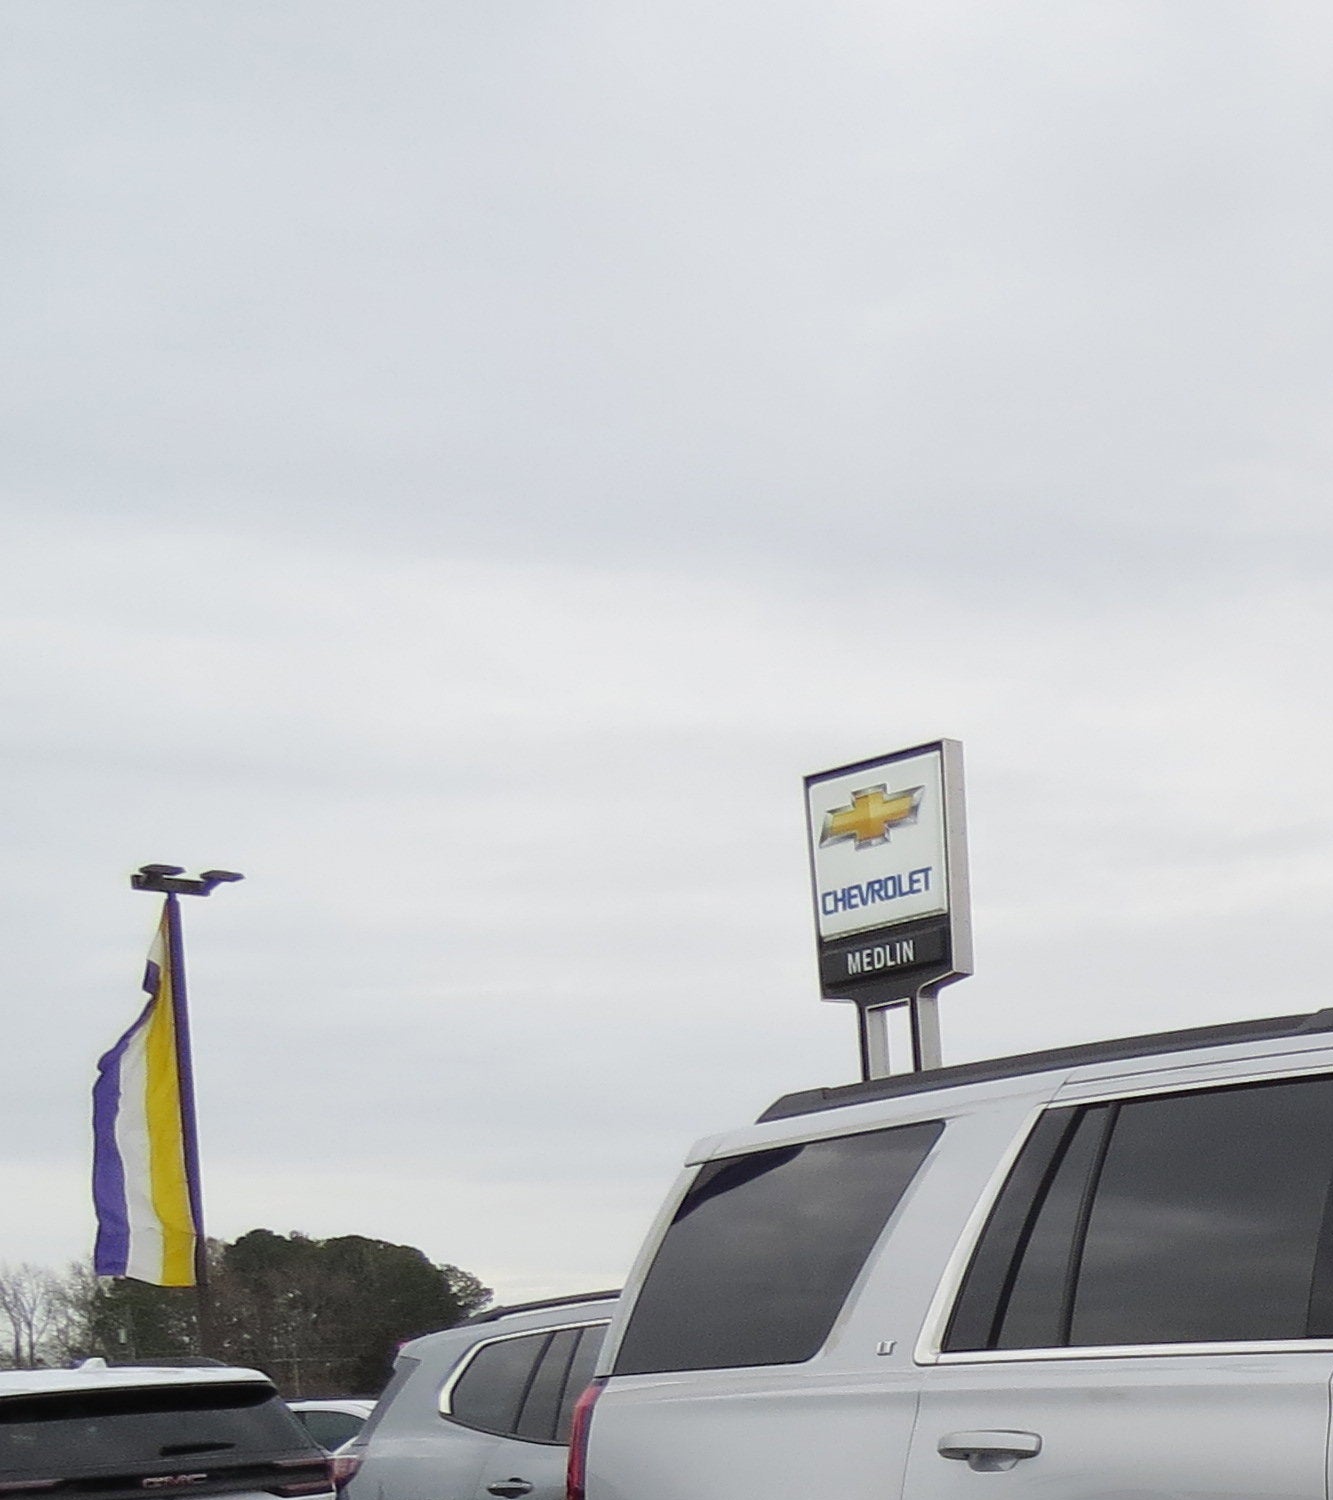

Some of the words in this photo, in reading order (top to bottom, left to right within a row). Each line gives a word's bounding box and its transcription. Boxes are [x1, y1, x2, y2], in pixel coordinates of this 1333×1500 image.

[820, 866, 933, 916] CHEVROLET
[847, 939, 916, 975] MEDLIN
[876, 1340, 897, 1357] LT
[142, 1473, 208, 1489] GMC
